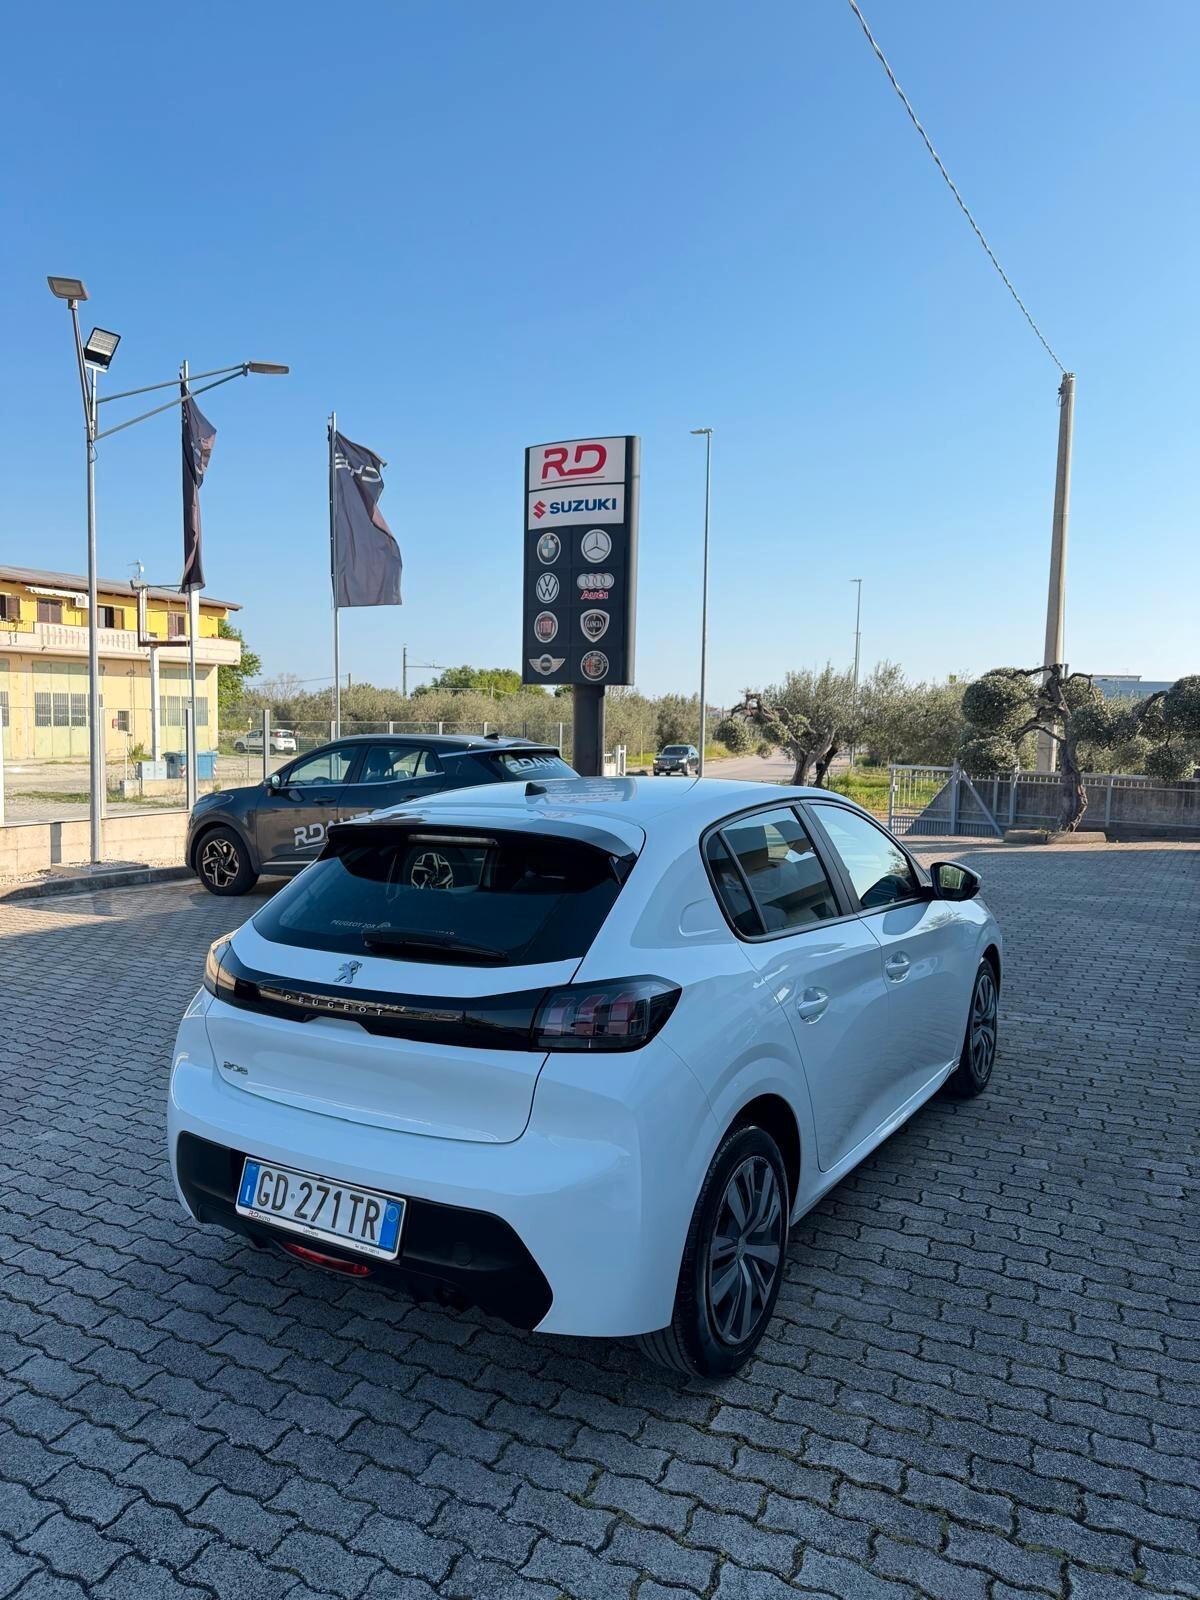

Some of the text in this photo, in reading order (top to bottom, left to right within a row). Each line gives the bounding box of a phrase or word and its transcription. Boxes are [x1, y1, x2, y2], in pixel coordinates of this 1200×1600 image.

[541, 443, 607, 480] RD
[549, 497, 617, 515] SUZUKI
[285, 994, 383, 1016] PEUGEOT
